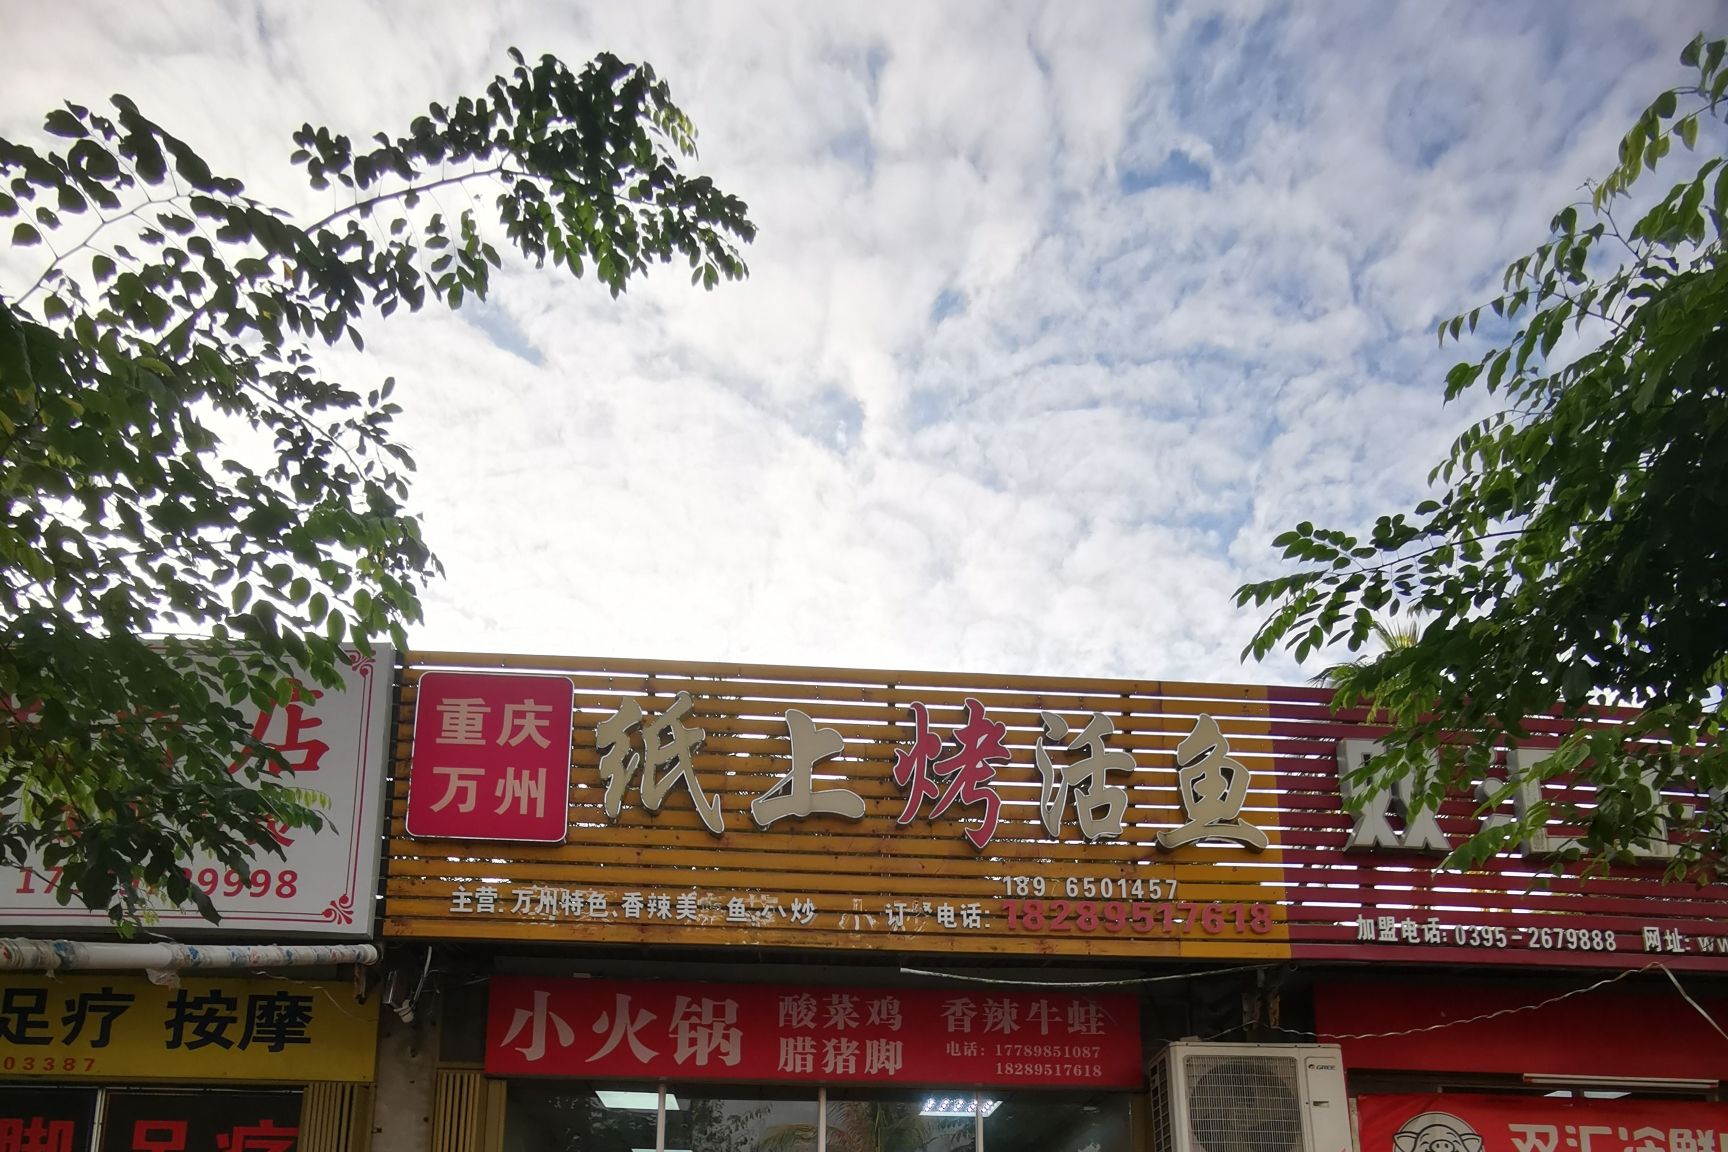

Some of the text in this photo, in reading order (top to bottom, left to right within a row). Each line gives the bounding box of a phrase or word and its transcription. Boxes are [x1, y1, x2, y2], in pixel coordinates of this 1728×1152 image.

[435, 697, 551, 750] 重庆
[430, 765, 546, 818] 万州
[595, 690, 1269, 852] 纸上烤活鱼
[1001, 899, 1273, 935] 18289517618
[0, 987, 314, 1052] 足疗 按摩
[500, 990, 1106, 1066] 小火锅 酸菜鸡 香辣牛蛙
[777, 1036, 903, 1076] 腊猪脚
[995, 1062, 1102, 1078] 18289517618
